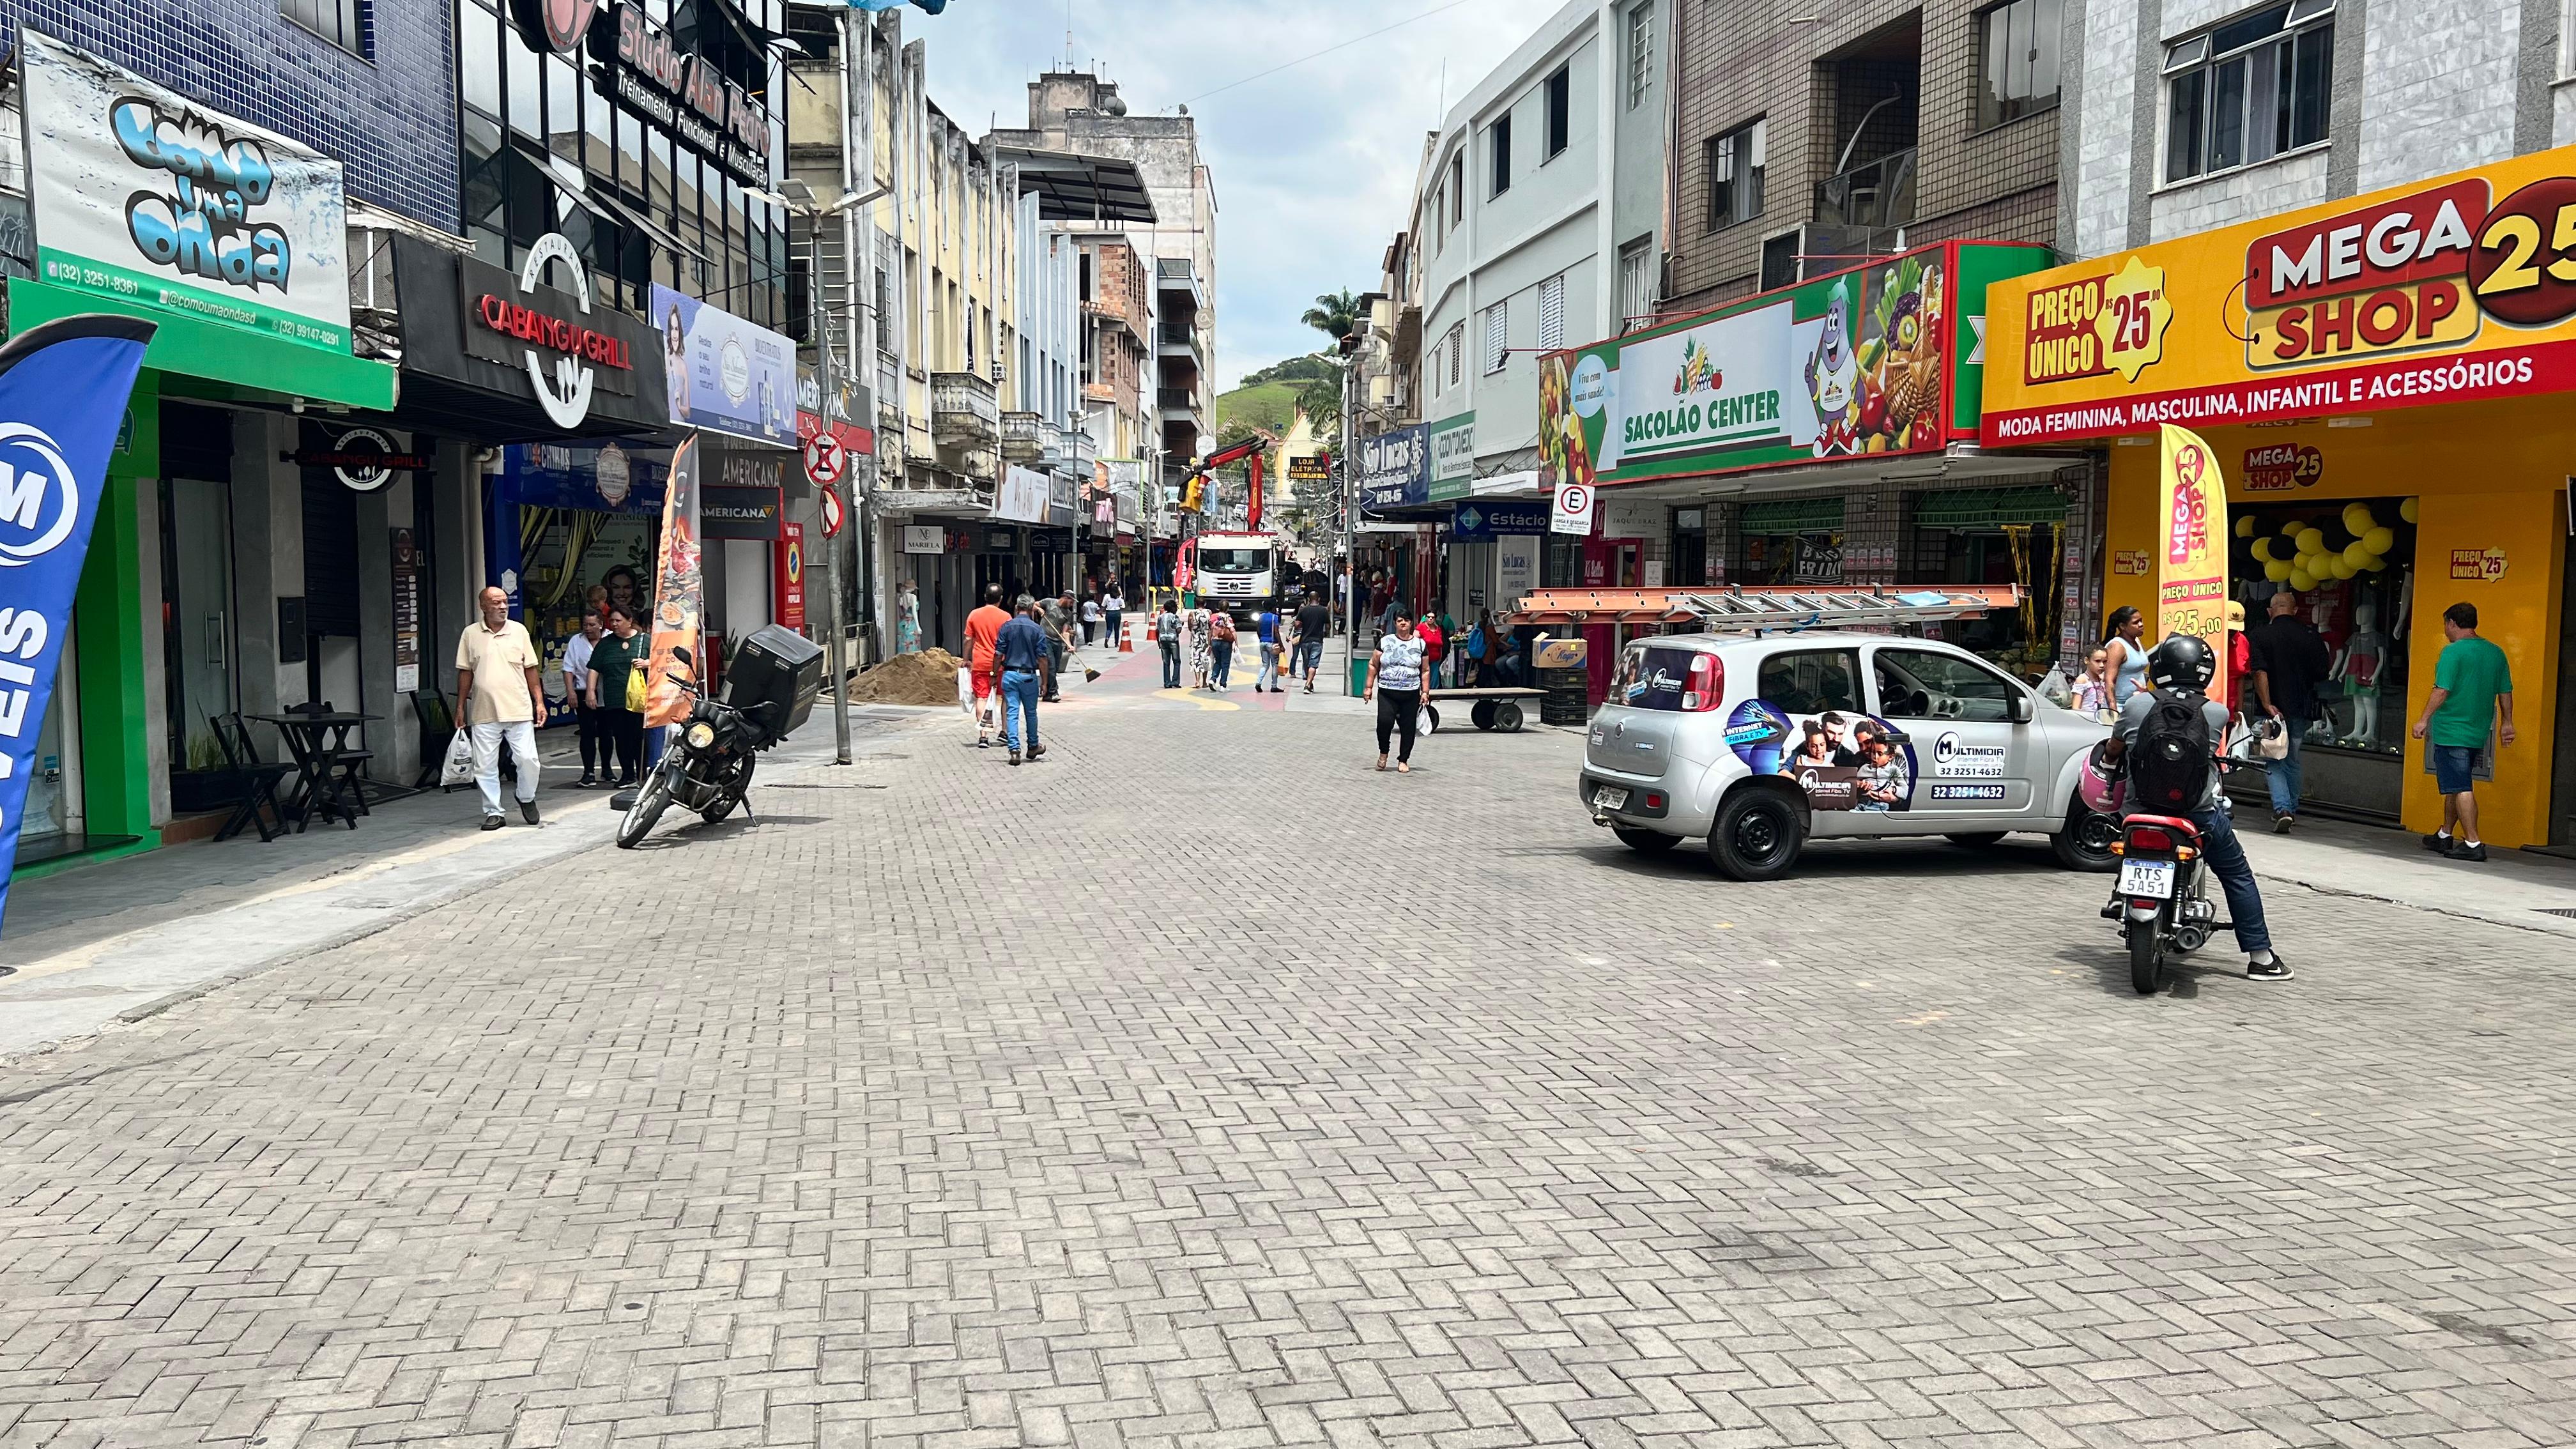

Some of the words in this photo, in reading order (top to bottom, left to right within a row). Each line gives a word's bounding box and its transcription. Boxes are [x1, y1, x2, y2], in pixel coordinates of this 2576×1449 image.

[619, 5, 682, 93] Studio
[685, 57, 724, 126] Alan
[728, 86, 770, 158] Pedro
[618, 66, 673, 124] Treinamento
[677, 111, 717, 154] Funcional
[719, 142, 725, 159] e
[2271, 199, 2473, 294] MEGA
[2478, 203, 2576, 296] 25
[58, 263, 80, 285] (32)
[84, 268, 139, 296] 3251-8361
[167, 291, 256, 325] @comoumaondasd
[2031, 281, 2098, 331] PREÇO
[2274, 280, 2460, 360] SHOP
[279, 319, 295, 336] (32)
[296, 321, 339, 346] 99147-0291
[482, 294, 582, 355] CABANGU
[583, 330, 634, 371] GRILL
[2029, 333, 2096, 379] ÚNICO
[1578, 374, 1590, 385] Viva
[1590, 372, 1601, 383] com
[1574, 390, 1587, 402] mais
[1998, 415, 2043, 438] MODA
[2046, 406, 2127, 434] FEMININA,
[2132, 392, 2244, 424] MASCULINA,
[2246, 381, 2343, 413] INFANTIL
[2349, 378, 2363, 401] E
[2368, 357, 2533, 399] ACESSÓRIOS
[1625, 399, 1702, 443] SACOLÃO
[1707, 389, 1781, 430] CENTER
[722, 456, 780, 488] AMERICANA
[2179, 447, 2198, 484] 25
[2249, 447, 2294, 468] MEGA
[2295, 453, 2321, 477] 25
[2250, 471, 2292, 489] SHOP
[1568, 491, 1581, 509] E
[1489, 512, 1547, 526] Estácio
[2172, 487, 2190, 556] MEGA
[2189, 487, 2206, 550] SHOP
[2452, 564, 2480, 578] ÚNICO
[2453, 551, 2481, 565] PREÇO
[2485, 556, 2501, 574] 25
[2162, 585, 2189, 601] PREÇO
[2192, 579, 2223, 598] ÚNICO
[2173, 609, 2223, 640] 25,00
[1726, 722, 1762, 735] INTERNET
[1933, 786, 1947, 797] 32
[1949, 786, 2003, 798] 3251-4632
[2127, 879, 2165, 894] 5A51
[2134, 867, 2163, 881] RTS
